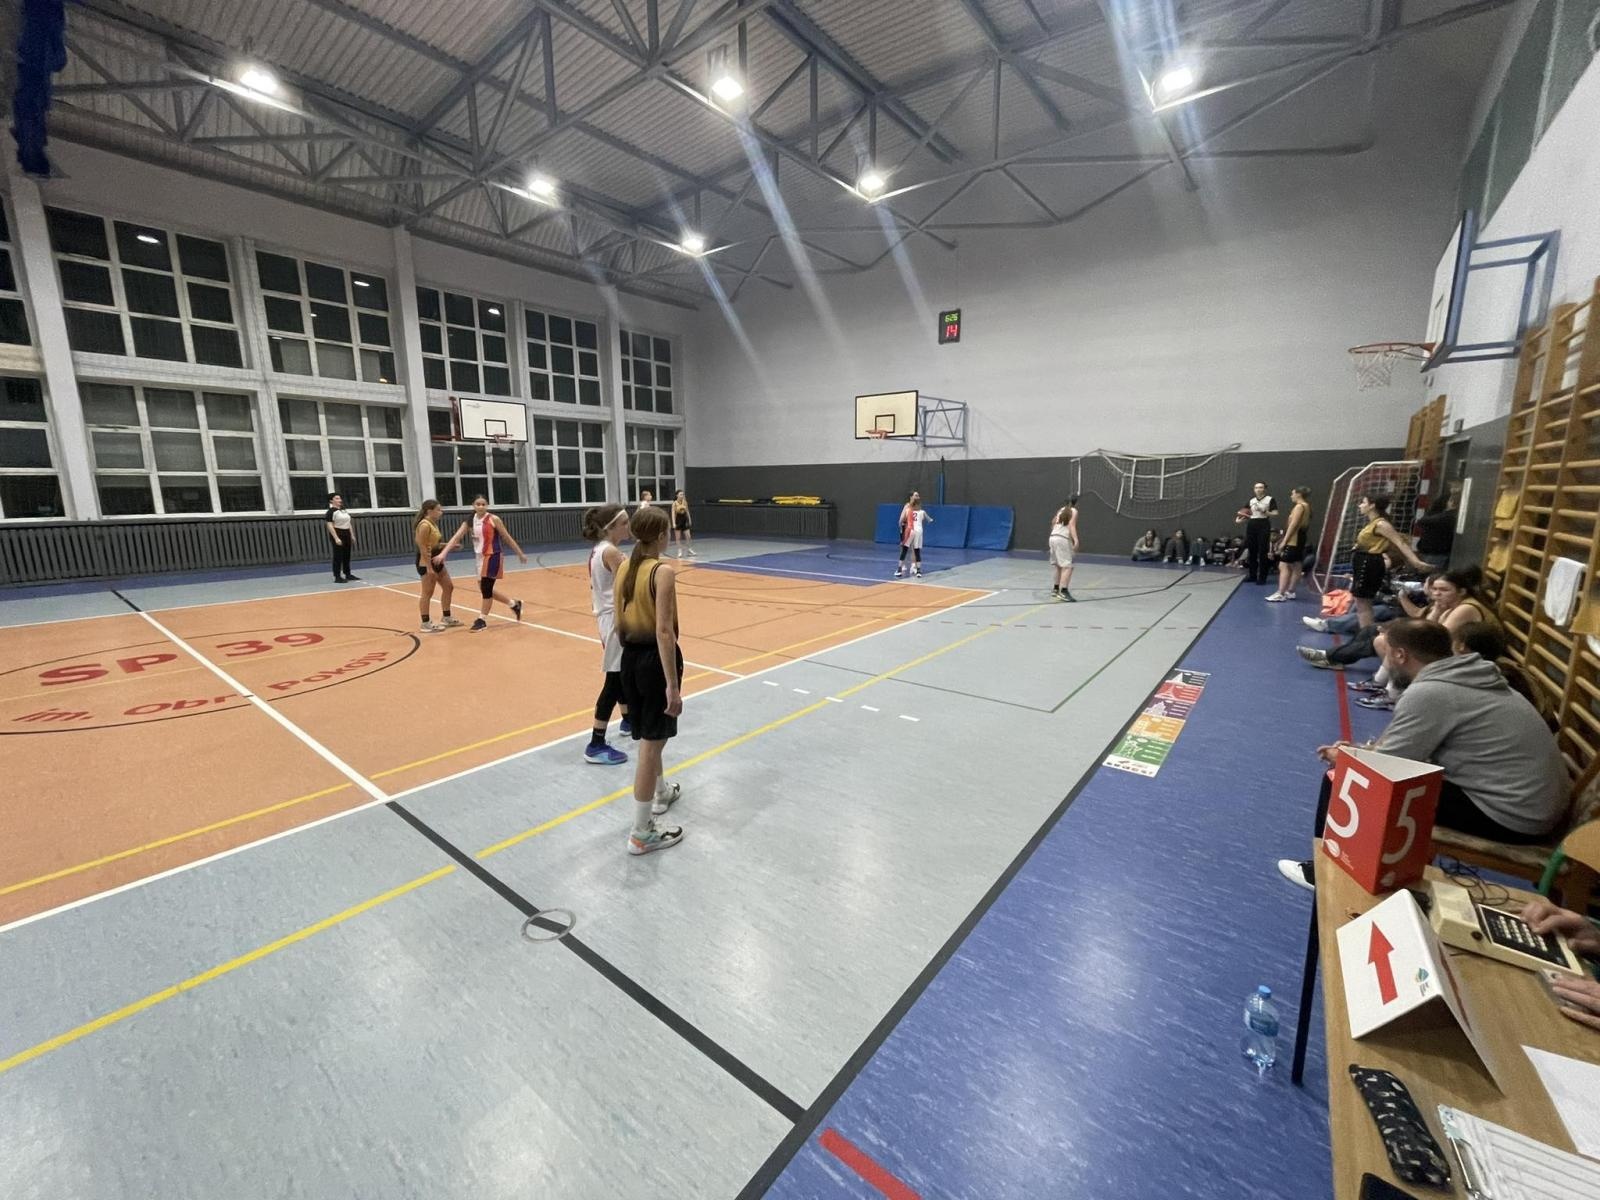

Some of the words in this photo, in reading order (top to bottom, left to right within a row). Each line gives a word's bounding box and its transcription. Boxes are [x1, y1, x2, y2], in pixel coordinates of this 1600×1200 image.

[946, 324, 958, 338] 14
[38, 654, 178, 687] SP
[216, 632, 325, 658] 39
[11, 708, 95, 722] im.
[1327, 766, 1370, 838] 5
[1381, 785, 1427, 865] 5
